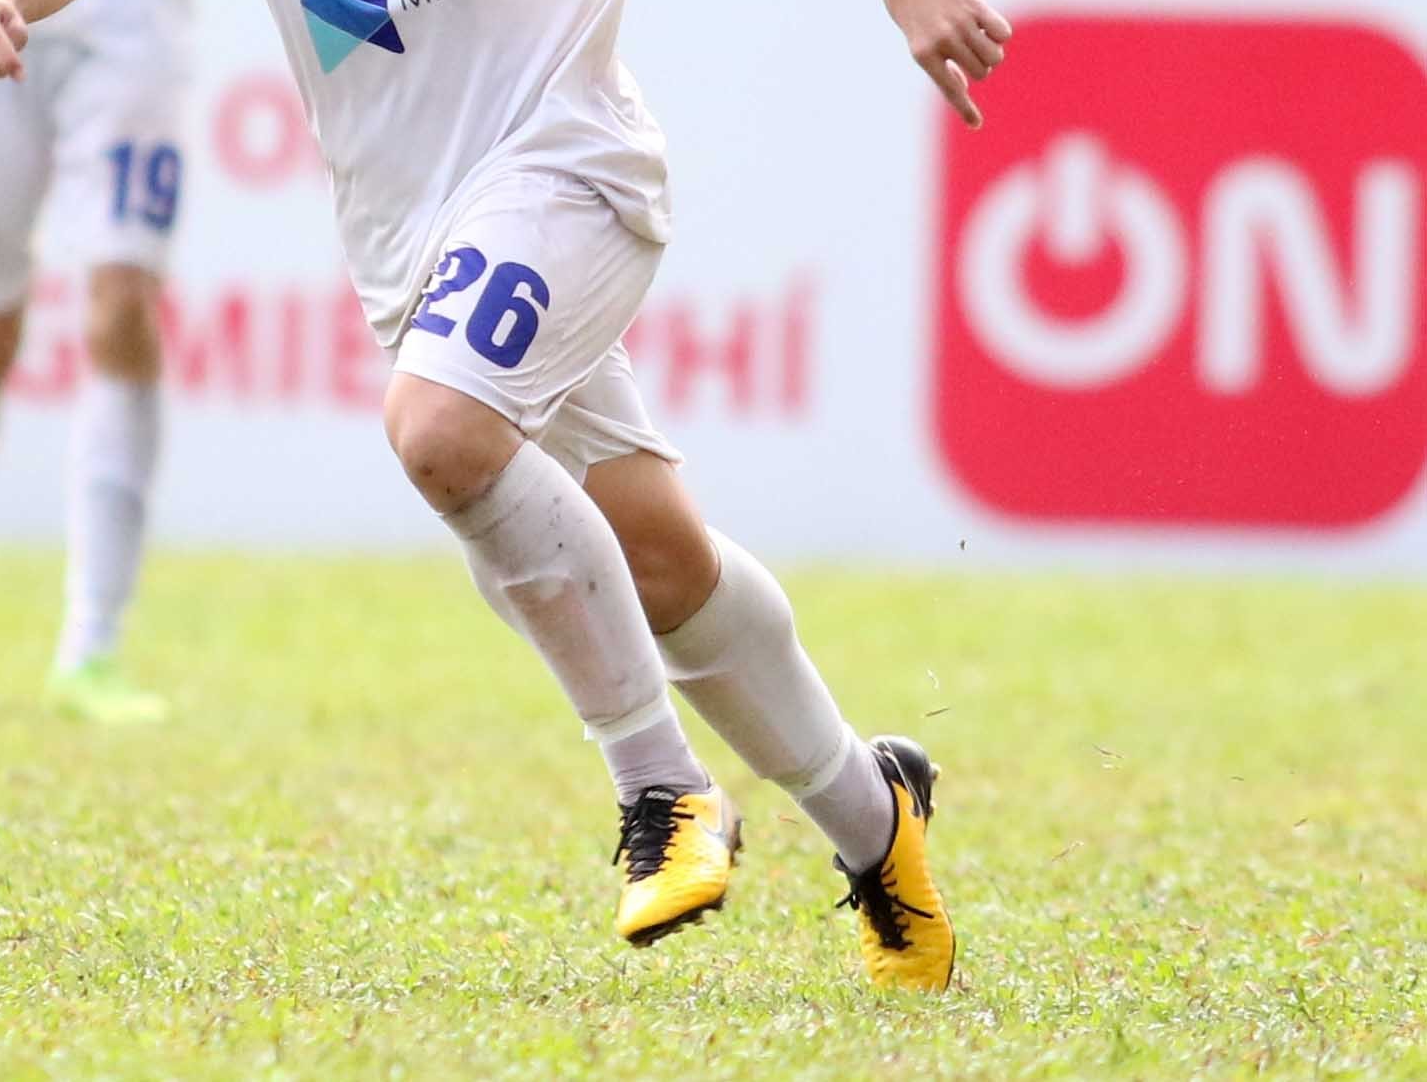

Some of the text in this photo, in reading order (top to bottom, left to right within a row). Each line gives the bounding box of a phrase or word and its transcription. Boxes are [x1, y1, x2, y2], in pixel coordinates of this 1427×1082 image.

[106, 140, 181, 231] 19
[411, 247, 550, 368] 26
[958, 128, 1422, 398] ON
